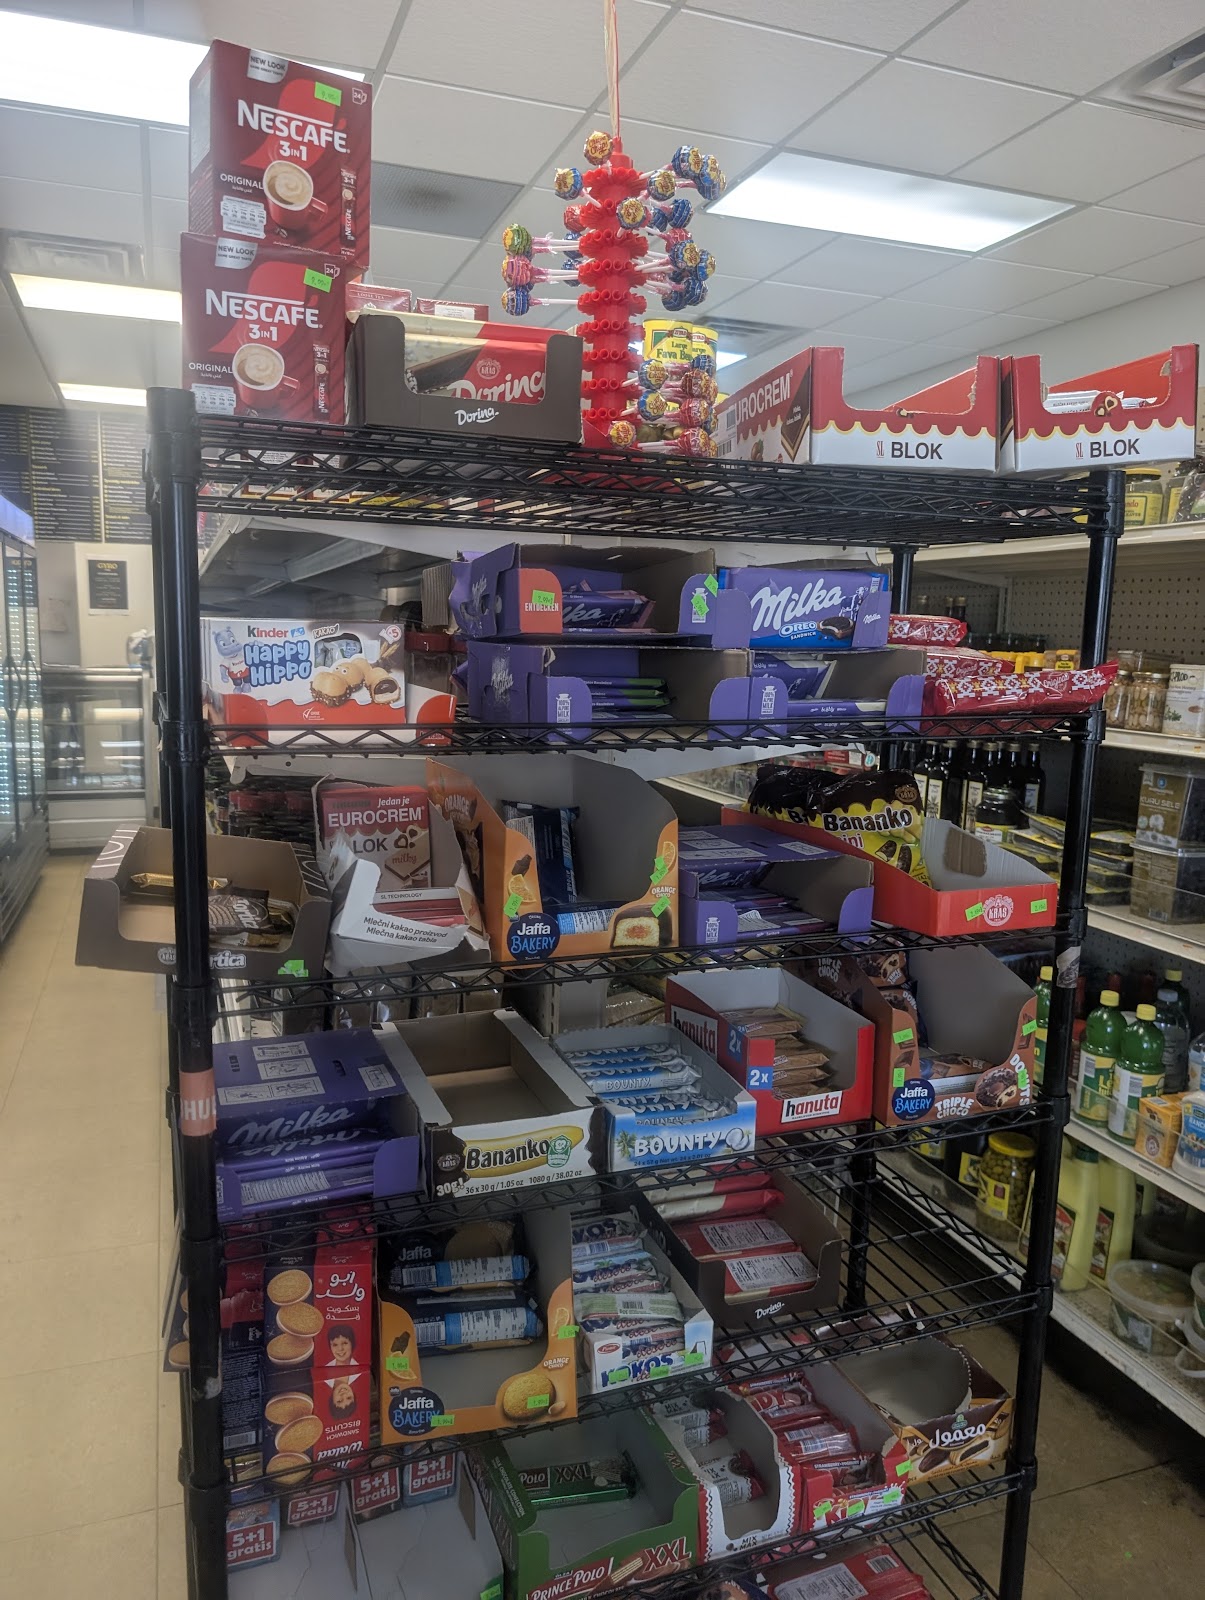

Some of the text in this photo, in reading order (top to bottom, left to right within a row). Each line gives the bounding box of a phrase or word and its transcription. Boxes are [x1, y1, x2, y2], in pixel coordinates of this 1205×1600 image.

[251, 56, 285, 71] NEW LOOK
[220, 173, 264, 189] ORIGINAL
[218, 245, 254, 256] NEW LOOK
[657, 349, 677, 359] Fava
[672, 342, 687, 350] Large
[188, 362, 233, 373] ORIGINAL
[736, 373, 791, 424] UROCREM
[455, 407, 499, 425] Dorina
[891, 441, 943, 460] BLOK
[1090, 438, 1140, 458] BLOK
[525, 603, 559, 611] ENTDECKEN
[750, 578, 846, 631] Milka
[863, 613, 881, 624] Milka
[248, 625, 288, 638] Kinder
[780, 621, 817, 635] OREO
[790, 632, 816, 640] SANDWICH
[245, 641, 310, 664] Happy
[250, 661, 312, 686] Hippo
[377, 796, 410, 809] Jedan je
[328, 807, 422, 827] EUROCREM
[823, 807, 913, 832] Bananko
[353, 838, 388, 853] LOK
[392, 855, 417, 864] milky
[364, 916, 448, 938] Mlečni kakao proizvod
[366, 927, 395, 938] Mlečna
[395, 932, 417, 942] kakao
[517, 923, 550, 935] Jaffa
[511, 935, 555, 953] BAKERY
[210, 952, 245, 967] rtica
[819, 967, 839, 982] CHOCO
[729, 1029, 741, 1053] 2x
[605, 1077, 651, 1090] BOUNTY
[750, 1069, 768, 1086] 2x
[900, 1087, 928, 1098] Jaffa
[785, 1095, 839, 1117] hanuta
[895, 1098, 932, 1113] BAKERY
[935, 1097, 974, 1111] TRIPLE
[937, 1107, 969, 1119] CHOCO
[228, 1106, 355, 1144] Milka
[634, 1131, 722, 1157] BOUNTY
[466, 1138, 549, 1170] Bananko
[436, 1178, 465, 1197] 30g!
[501, 1180, 514, 1188] 1.05
[529, 1175, 545, 1183] 1080
[556, 1171, 574, 1179] 38.02
[399, 1246, 432, 1261] Jaffa
[755, 1302, 785, 1319] Dorina
[543, 1358, 569, 1367] ORANGE
[399, 1397, 434, 1409] Jaffa
[325, 1420, 360, 1433] BISCUITS
[327, 1429, 360, 1440] SANDWICH
[929, 1424, 986, 1448] معمول
[417, 1453, 446, 1476] 5+1
[412, 1469, 451, 1489] gratis
[556, 1464, 591, 1484] XXL
[360, 1472, 389, 1494] 5+1
[297, 1497, 328, 1511] 5+1
[356, 1486, 396, 1506] gratis
[291, 1505, 334, 1521] gratis
[232, 1528, 264, 1547] 5+1
[740, 1541, 757, 1550] MAX
[742, 1536, 757, 1544] MIX
[227, 1541, 271, 1560] gratis
[643, 1536, 692, 1573] XXL
[531, 1566, 605, 1600] PRINCE POLO
